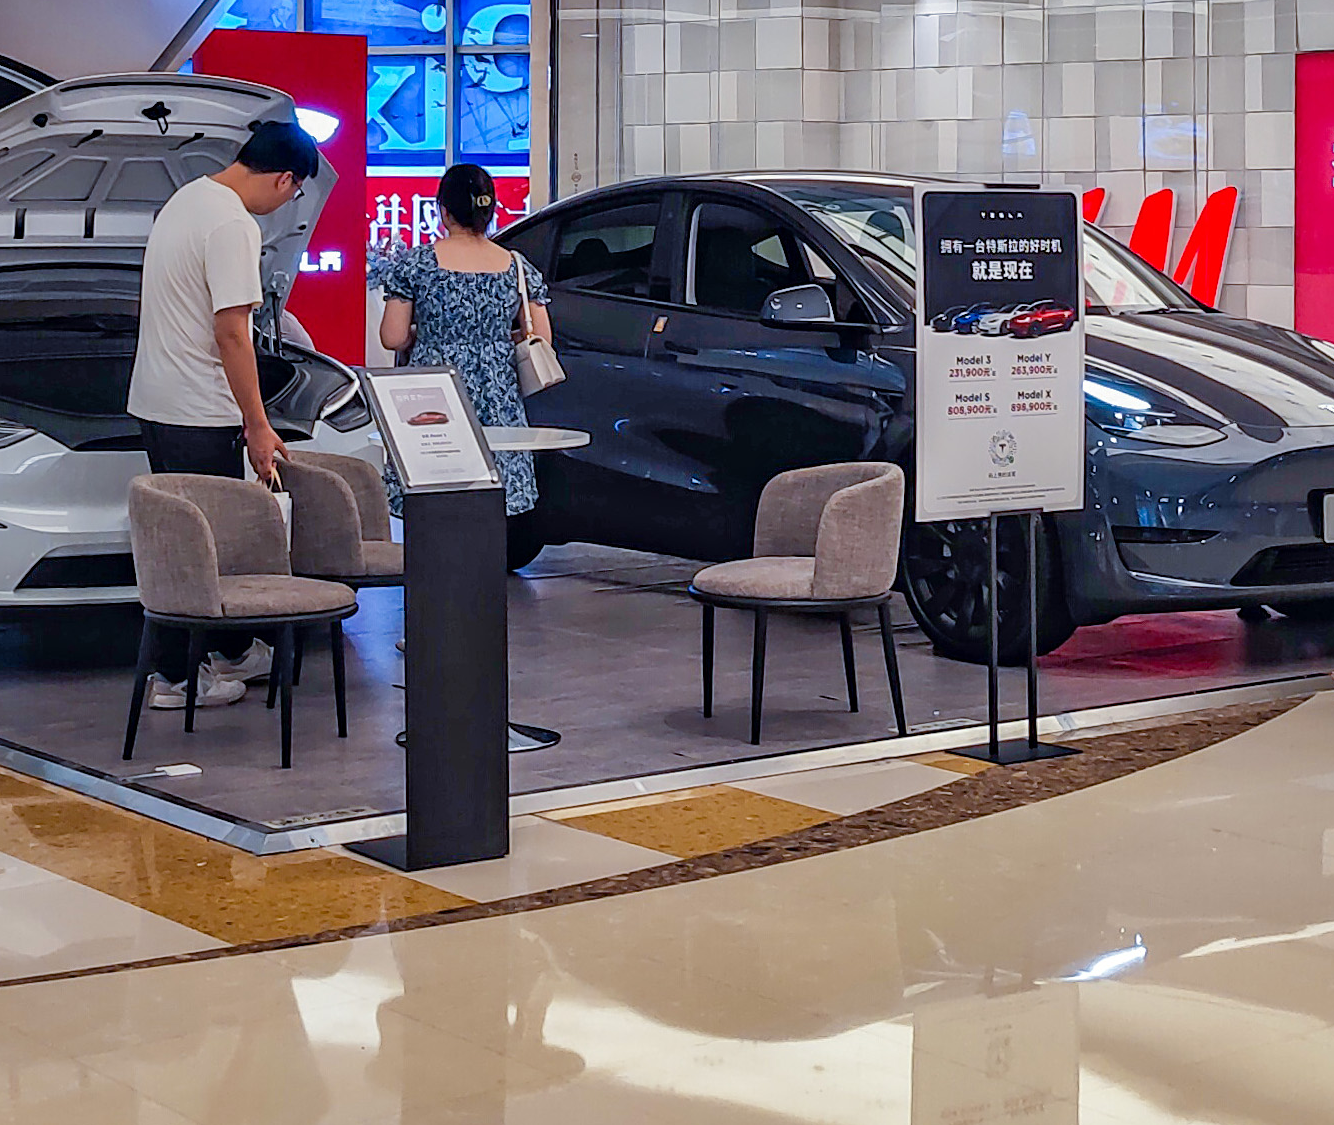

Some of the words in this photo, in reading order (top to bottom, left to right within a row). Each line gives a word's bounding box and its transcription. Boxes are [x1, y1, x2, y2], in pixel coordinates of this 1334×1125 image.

[940, 238, 1063, 254] 拥有一台特斯拉的好时机
[971, 260, 1034, 281] 就是现在
[956, 356, 984, 365] Model
[986, 355, 992, 365] 3
[1017, 353, 1043, 363] Model
[1045, 353, 1052, 363] Y
[955, 393, 982, 403] Model
[985, 392, 991, 402] S
[1017, 390, 1044, 400] Model
[1045, 390, 1052, 399] X
